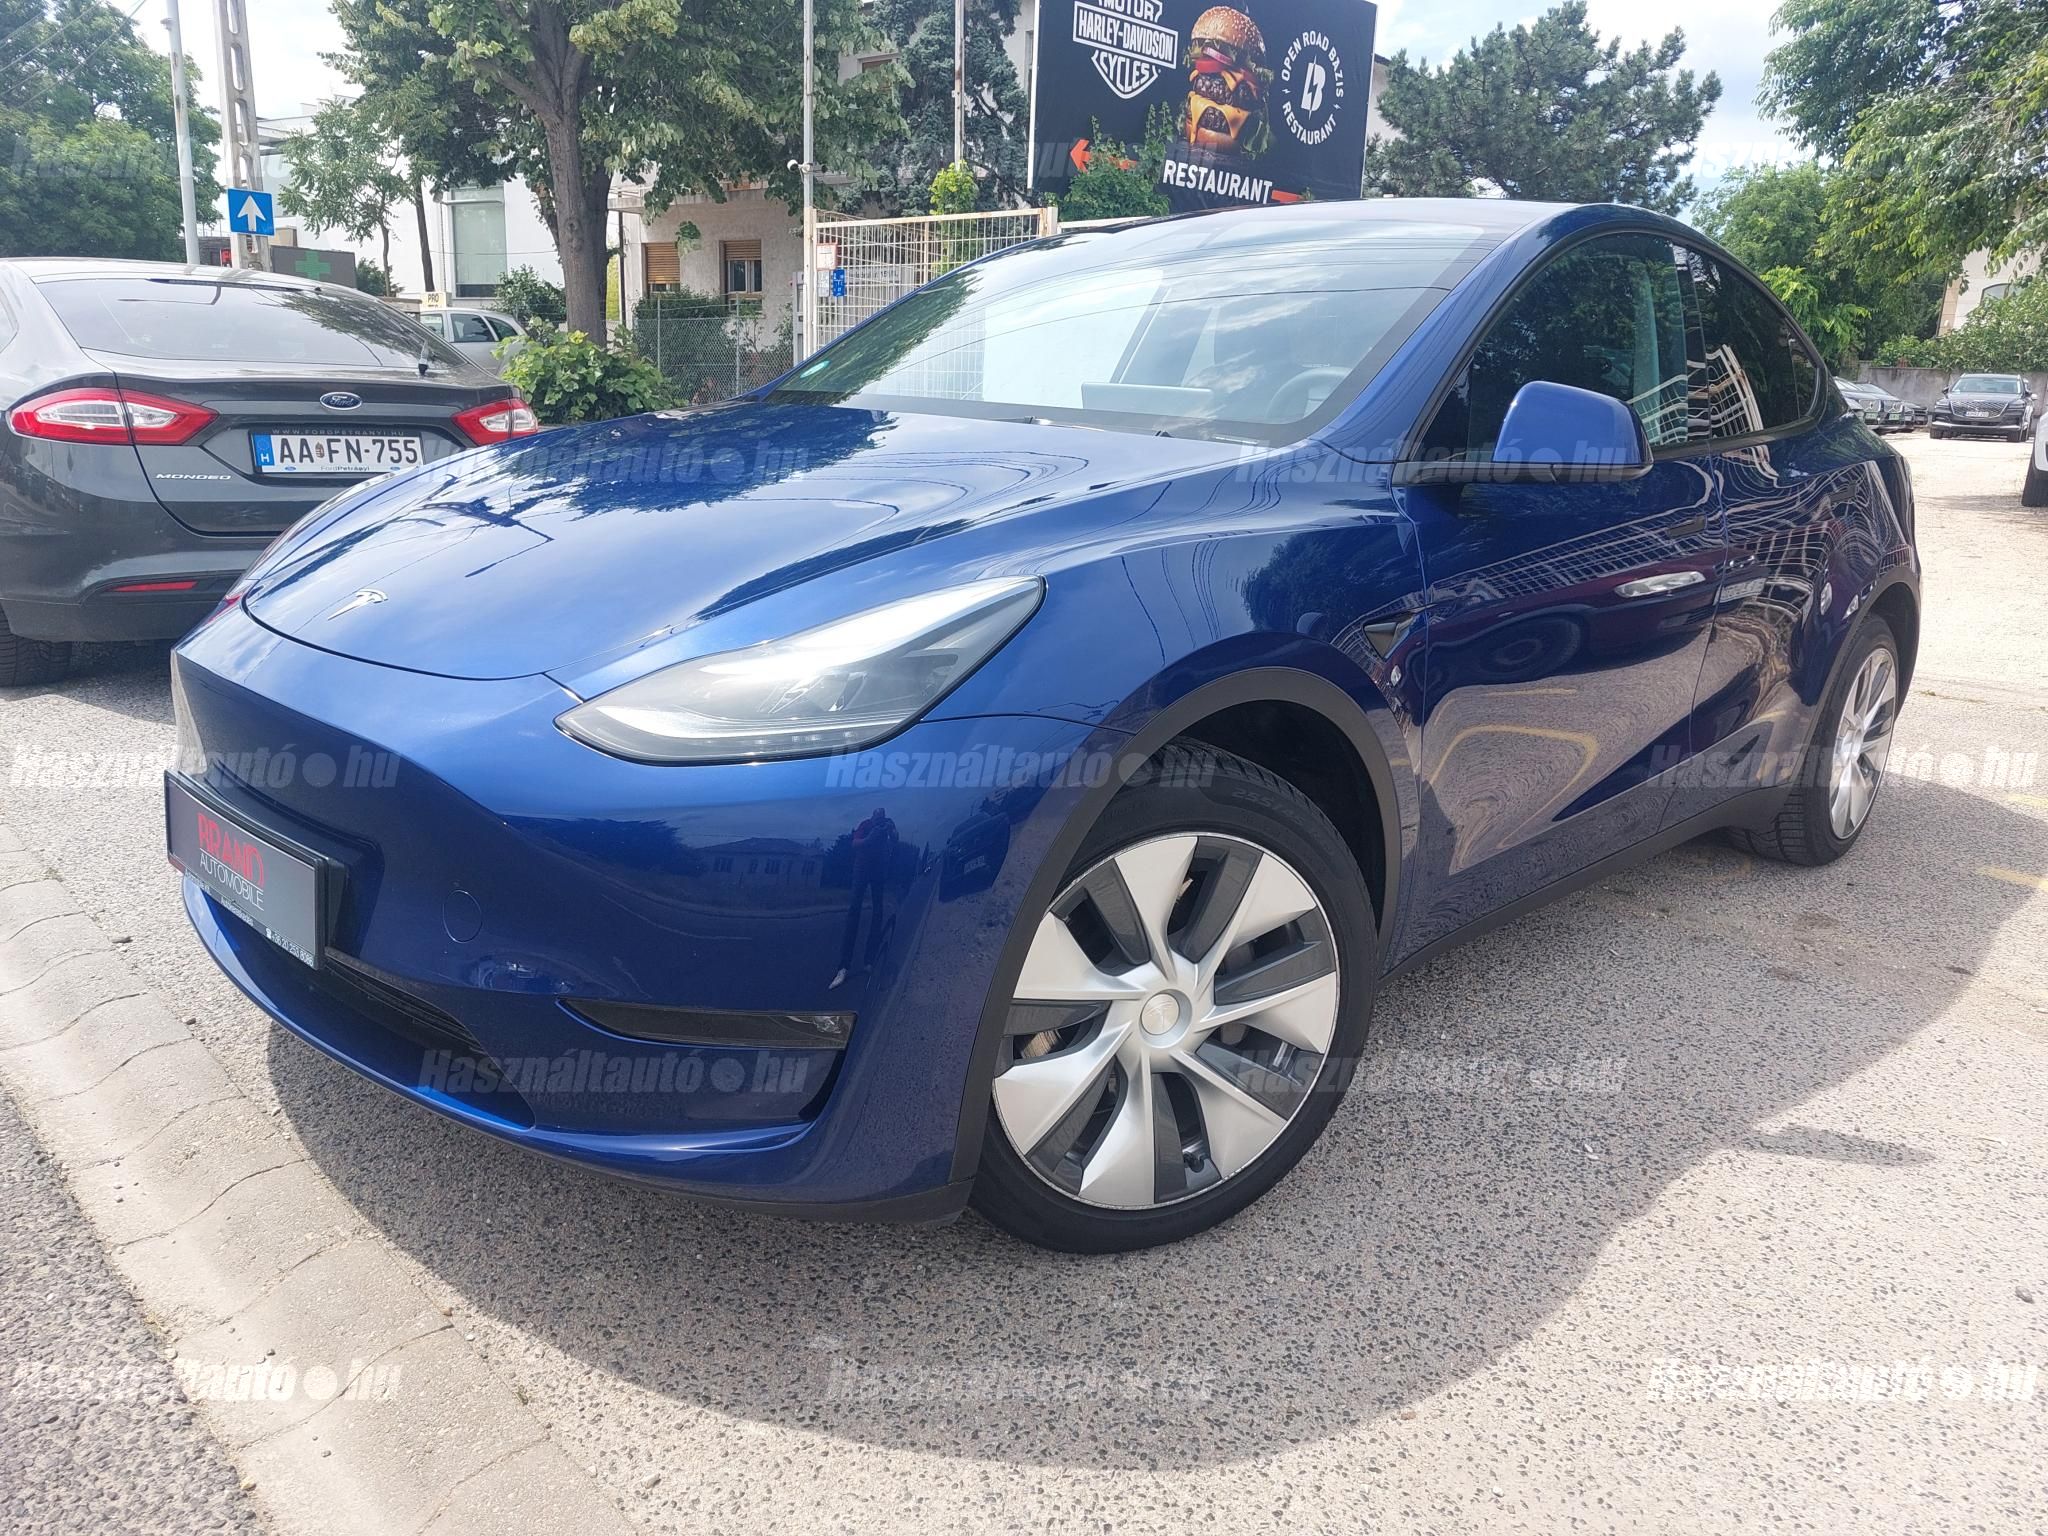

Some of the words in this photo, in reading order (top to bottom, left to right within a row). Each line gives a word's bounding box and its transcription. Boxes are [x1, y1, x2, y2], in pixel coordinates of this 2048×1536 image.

[1078, 8, 1174, 62] HARLEY-DAVIDSON
[1099, 51, 1150, 93] CYCLES
[1281, 38, 1302, 81] OPEN
[1302, 30, 1330, 51] ROAD
[1328, 46, 1344, 98] BAZIS
[1282, 101, 1337, 145] RESTAURANT
[1162, 159, 1273, 205] RESTAURANT
[260, 452, 271, 464] H
[197, 812, 265, 888] BRAND
[199, 852, 265, 907] AUTOMOBILE
